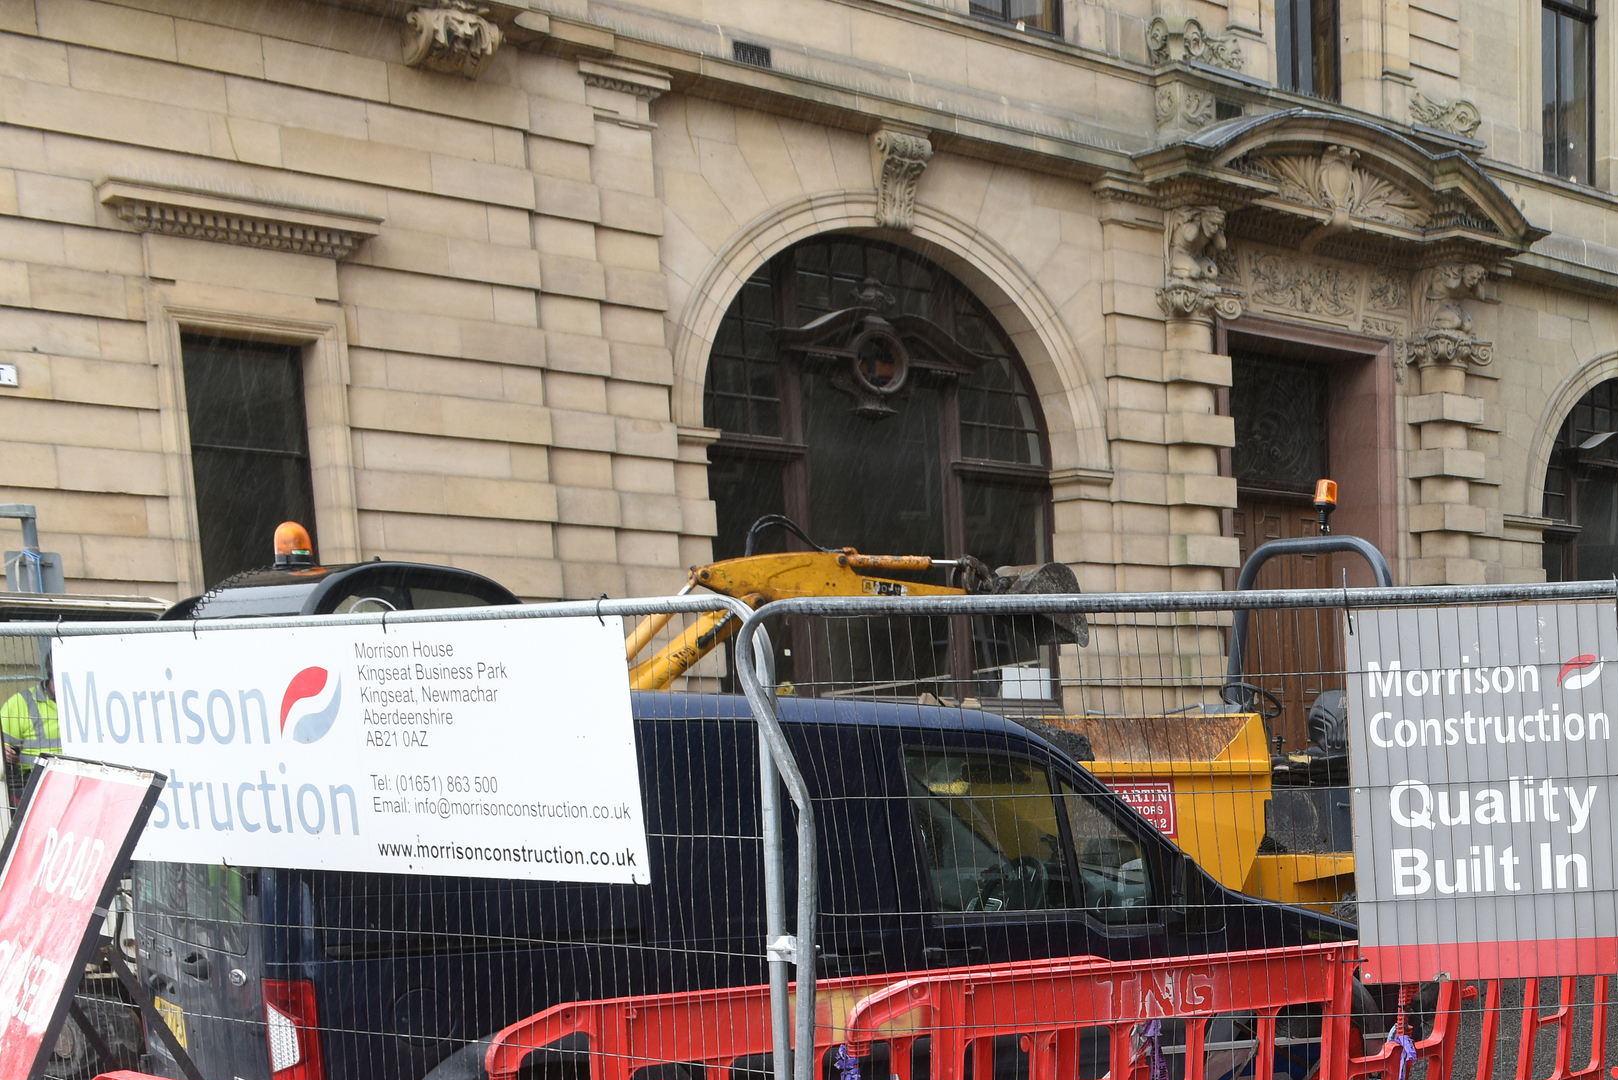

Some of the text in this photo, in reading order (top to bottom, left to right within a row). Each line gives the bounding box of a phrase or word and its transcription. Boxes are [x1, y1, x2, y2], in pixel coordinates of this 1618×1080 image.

[355, 641, 454, 659] Morrison House
[357, 662, 508, 685] Kingseat Business Park
[1367, 655, 1539, 698] Morrison
[61, 667, 271, 745] Morrison
[360, 685, 498, 707] Kingseat, Newmachar
[363, 708, 453, 725] Aberdeenshire
[1369, 703, 1610, 748] Construction
[366, 731, 429, 747] AB21 0AZ
[370, 774, 498, 796] Tel: (01651) 863 500
[146, 762, 360, 836] struction
[373, 796, 631, 820] Email: info@morrisonconstruction.co.uk
[1389, 776, 1598, 834] Quality
[33, 826, 105, 901] ROAD
[377, 841, 637, 867] www.morrisonconstruction.co.uk
[1390, 843, 1588, 896] Built In
